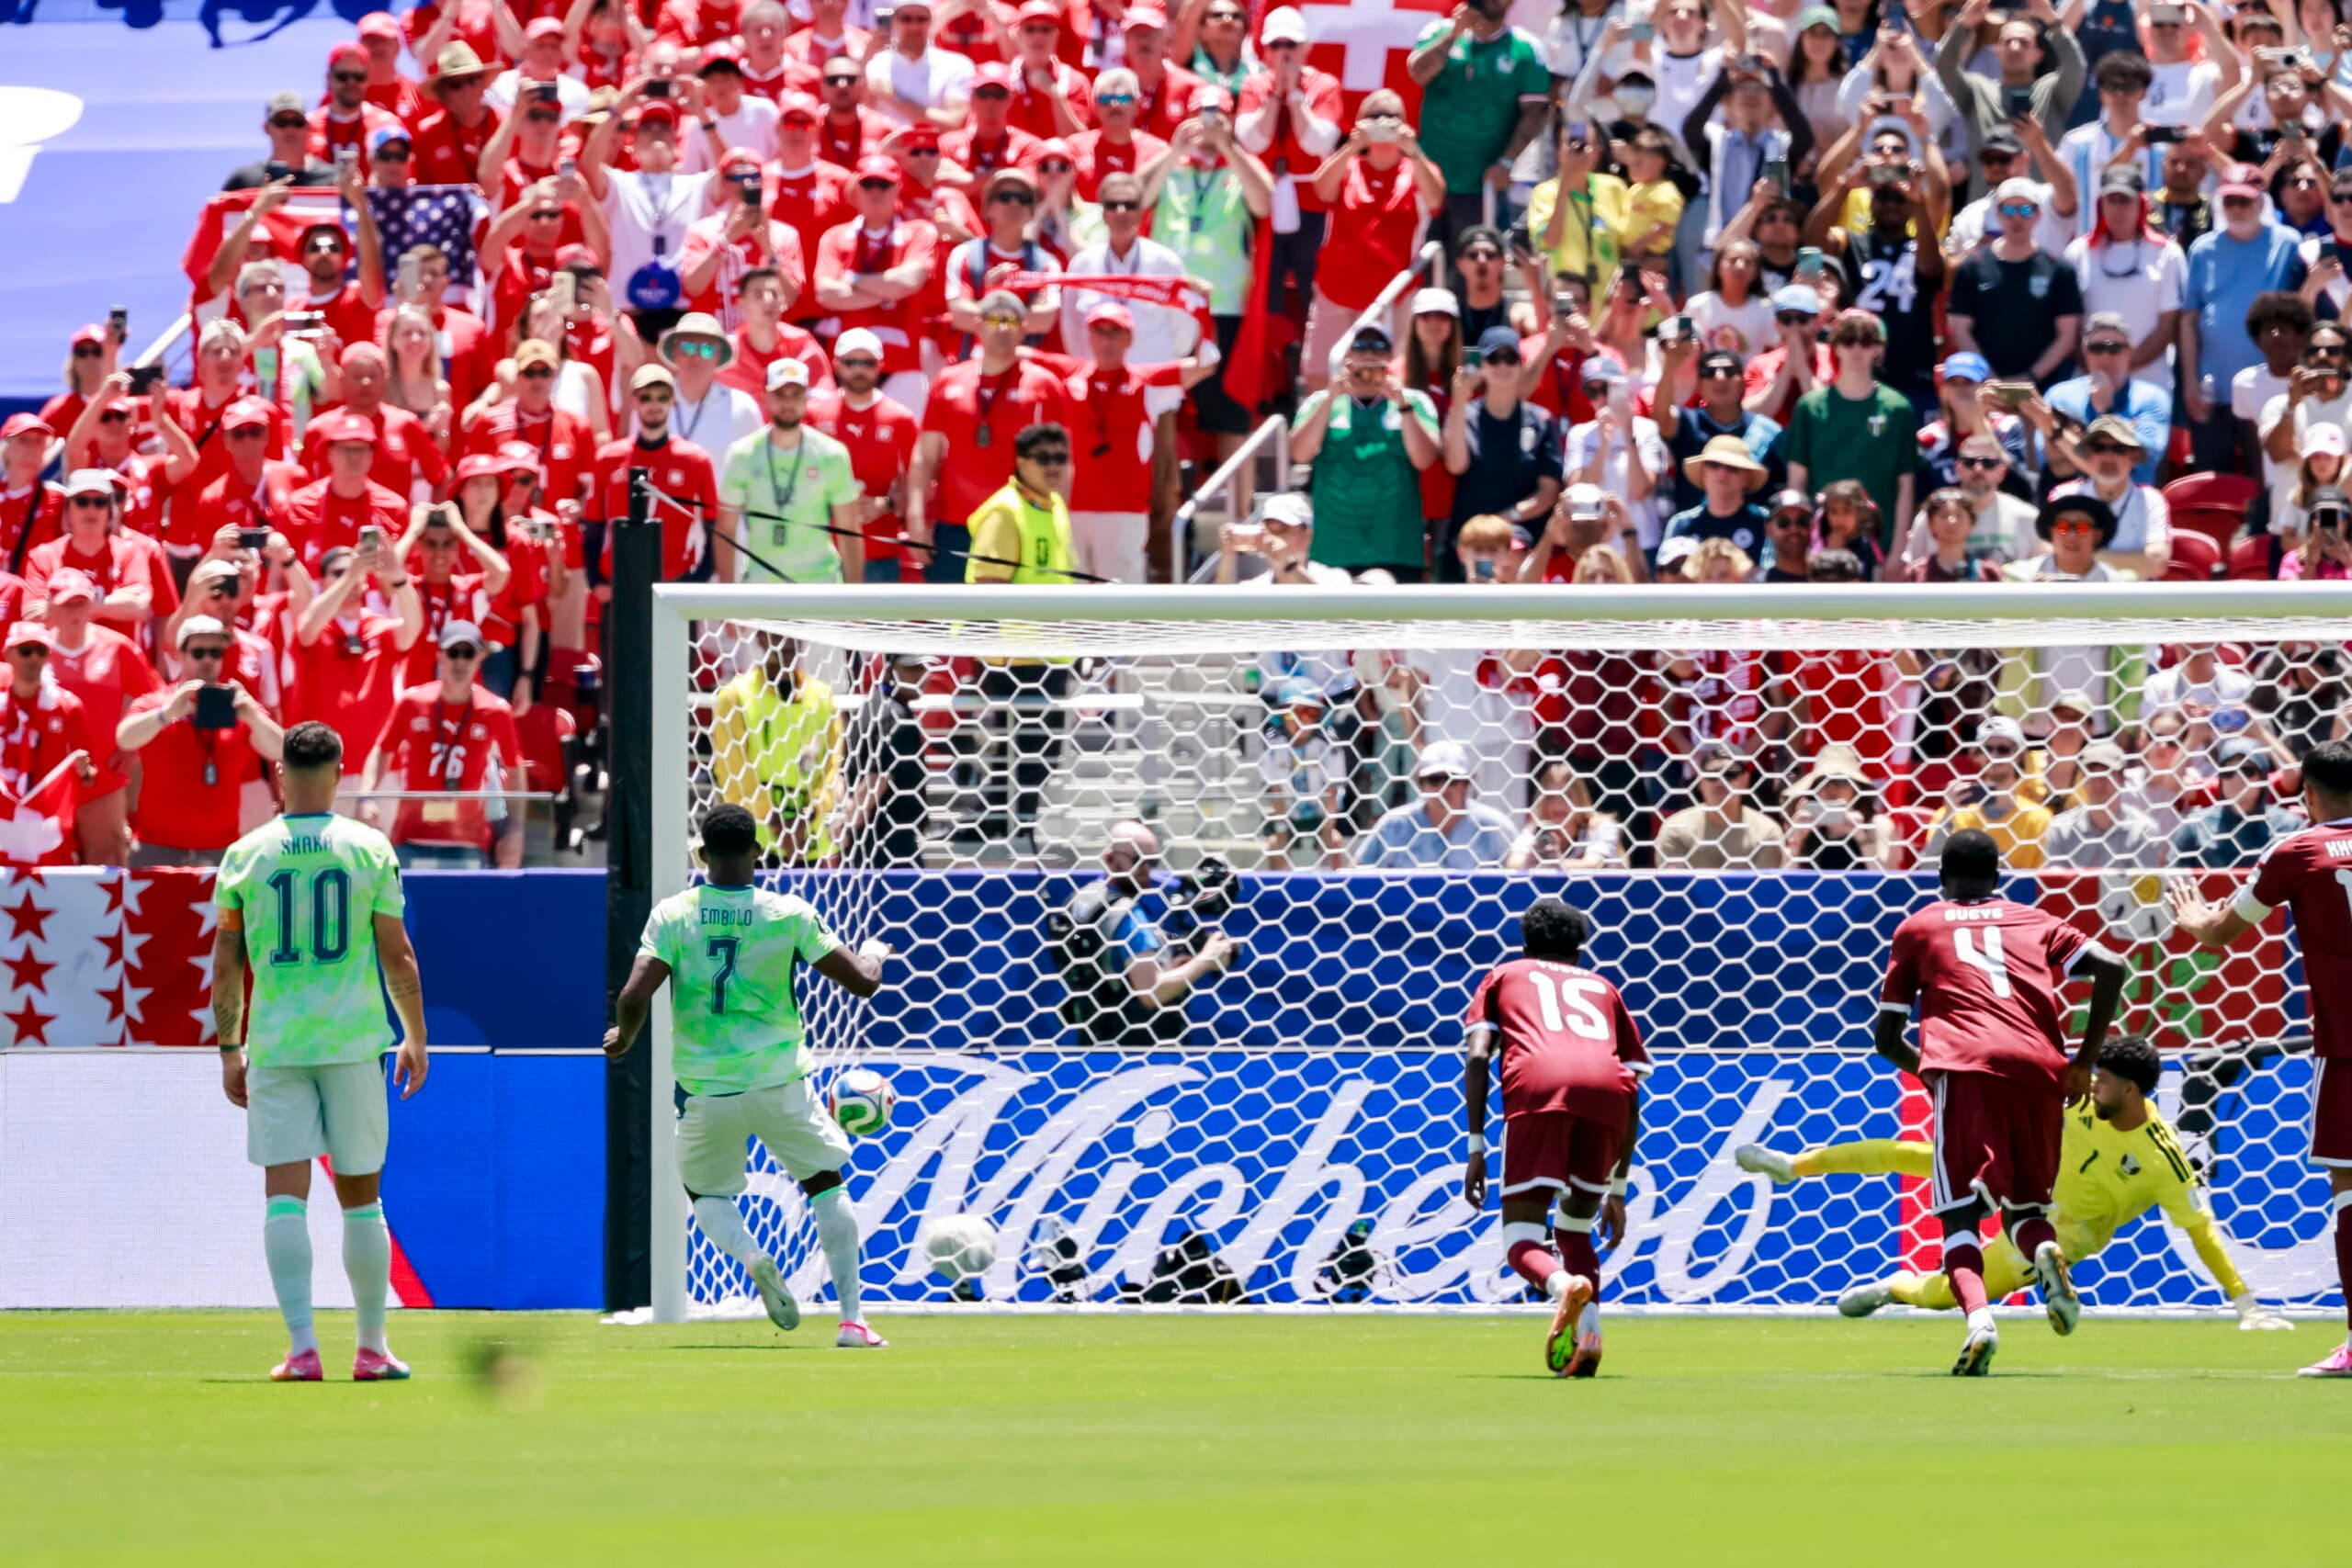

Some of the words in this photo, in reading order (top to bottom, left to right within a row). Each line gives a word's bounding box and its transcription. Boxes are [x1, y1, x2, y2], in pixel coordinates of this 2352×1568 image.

[1855, 251, 1917, 312] 24
[266, 866, 351, 967] 10
[700, 908, 752, 927] EMBOLO
[707, 935, 741, 1016] 7
[1953, 925, 2011, 999] 4
[1529, 970, 1610, 1041] 15
